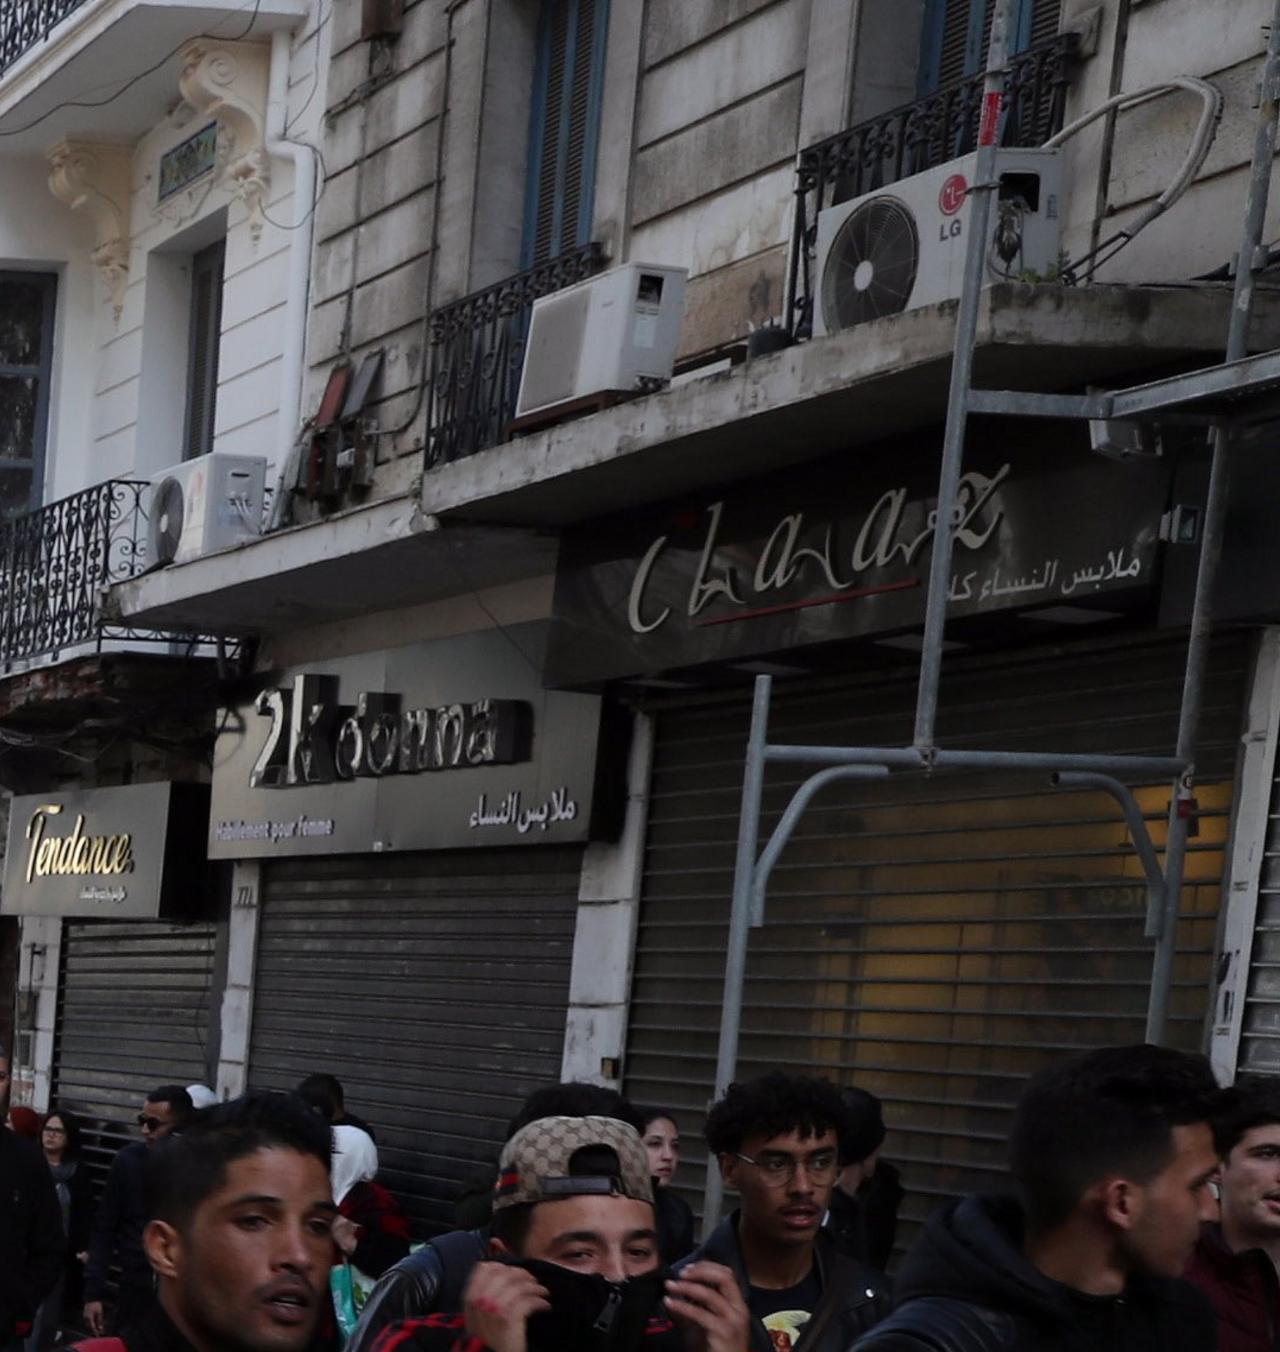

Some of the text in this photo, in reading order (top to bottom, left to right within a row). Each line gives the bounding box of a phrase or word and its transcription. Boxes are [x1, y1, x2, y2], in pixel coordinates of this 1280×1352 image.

[939, 220, 962, 242] LG
[977, 558, 1059, 602] النساء
[1060, 547, 1141, 595] ملابس
[469, 786, 578, 834] ملابس النساء
[25, 803, 132, 883] Tendance
